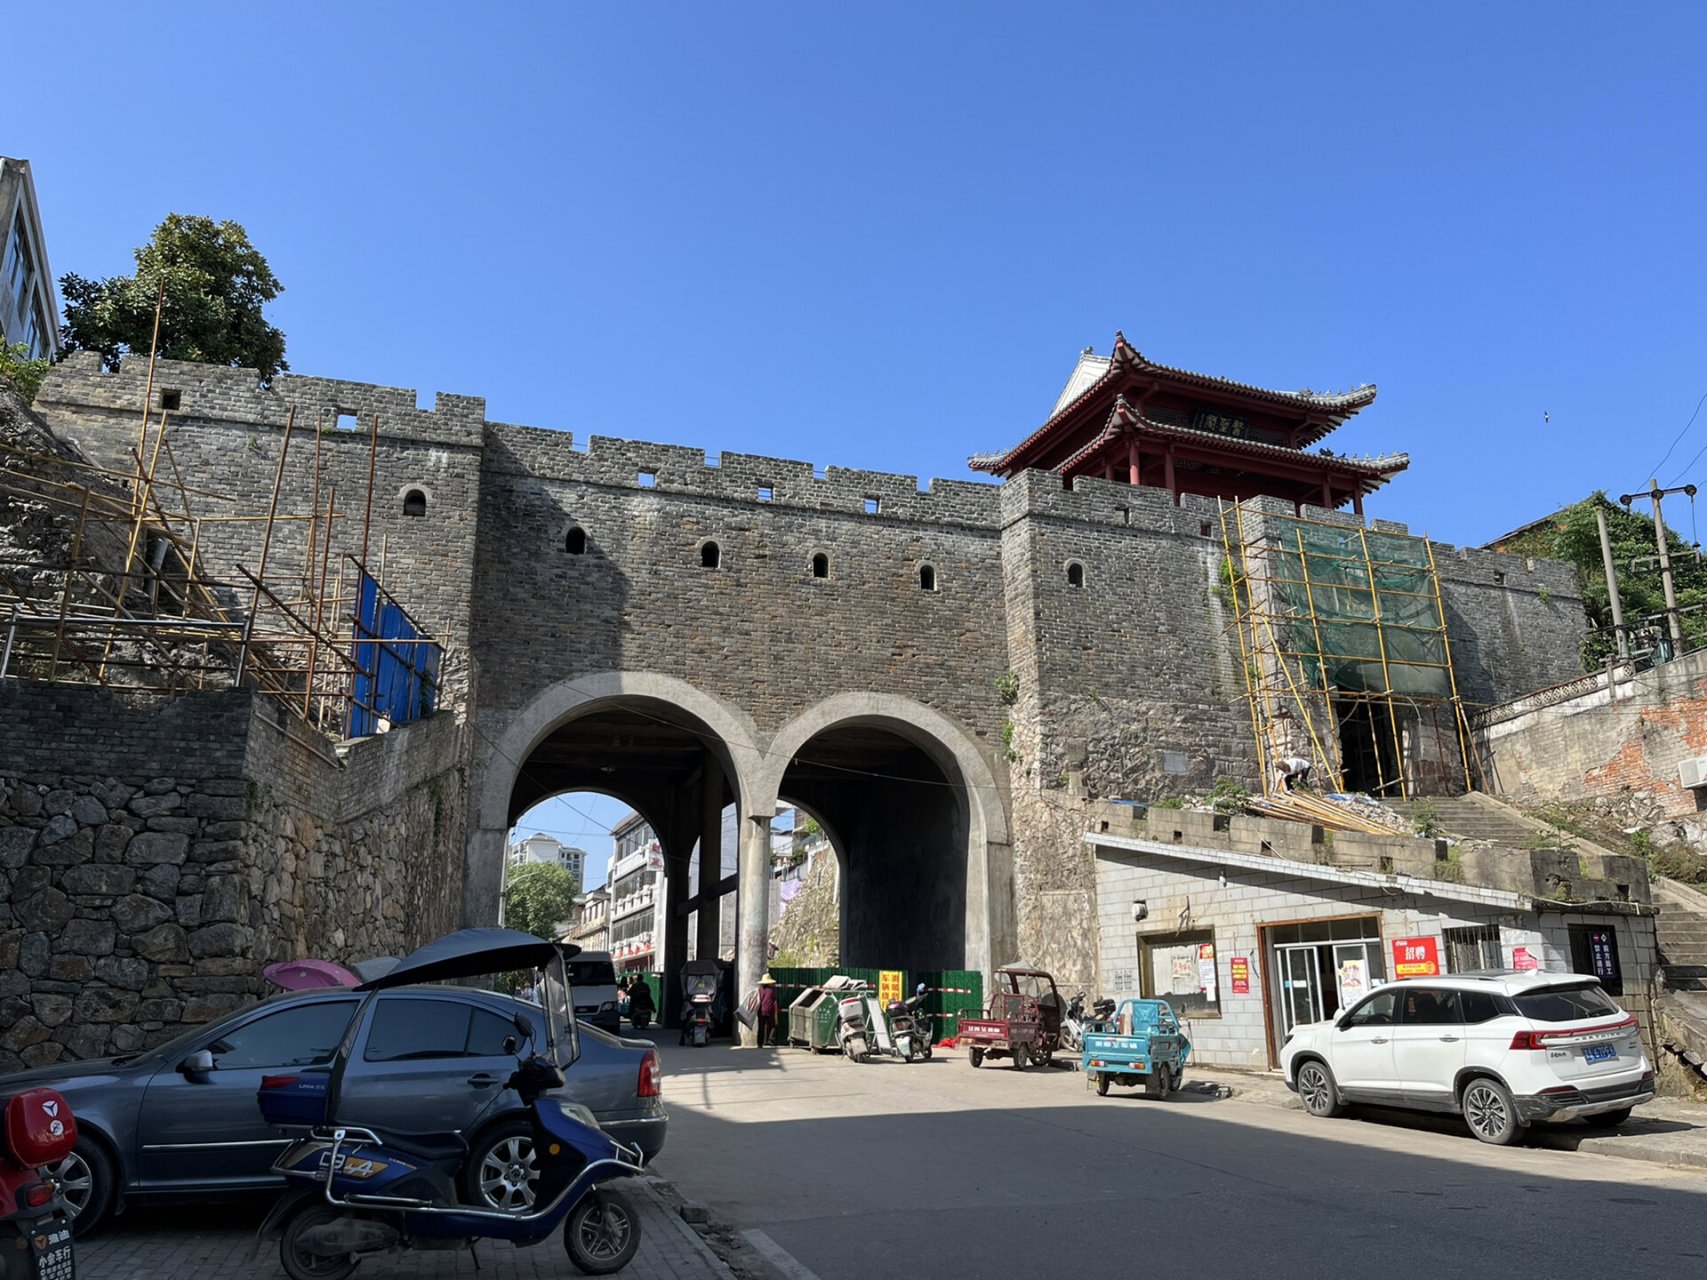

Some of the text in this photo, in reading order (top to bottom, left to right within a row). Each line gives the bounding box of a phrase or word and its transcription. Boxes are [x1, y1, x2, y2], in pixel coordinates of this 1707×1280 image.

[1405, 946, 1425, 960] 招聘
[1594, 944, 1604, 975] 禁止通行
[1603, 944, 1613, 975] 前方施工
